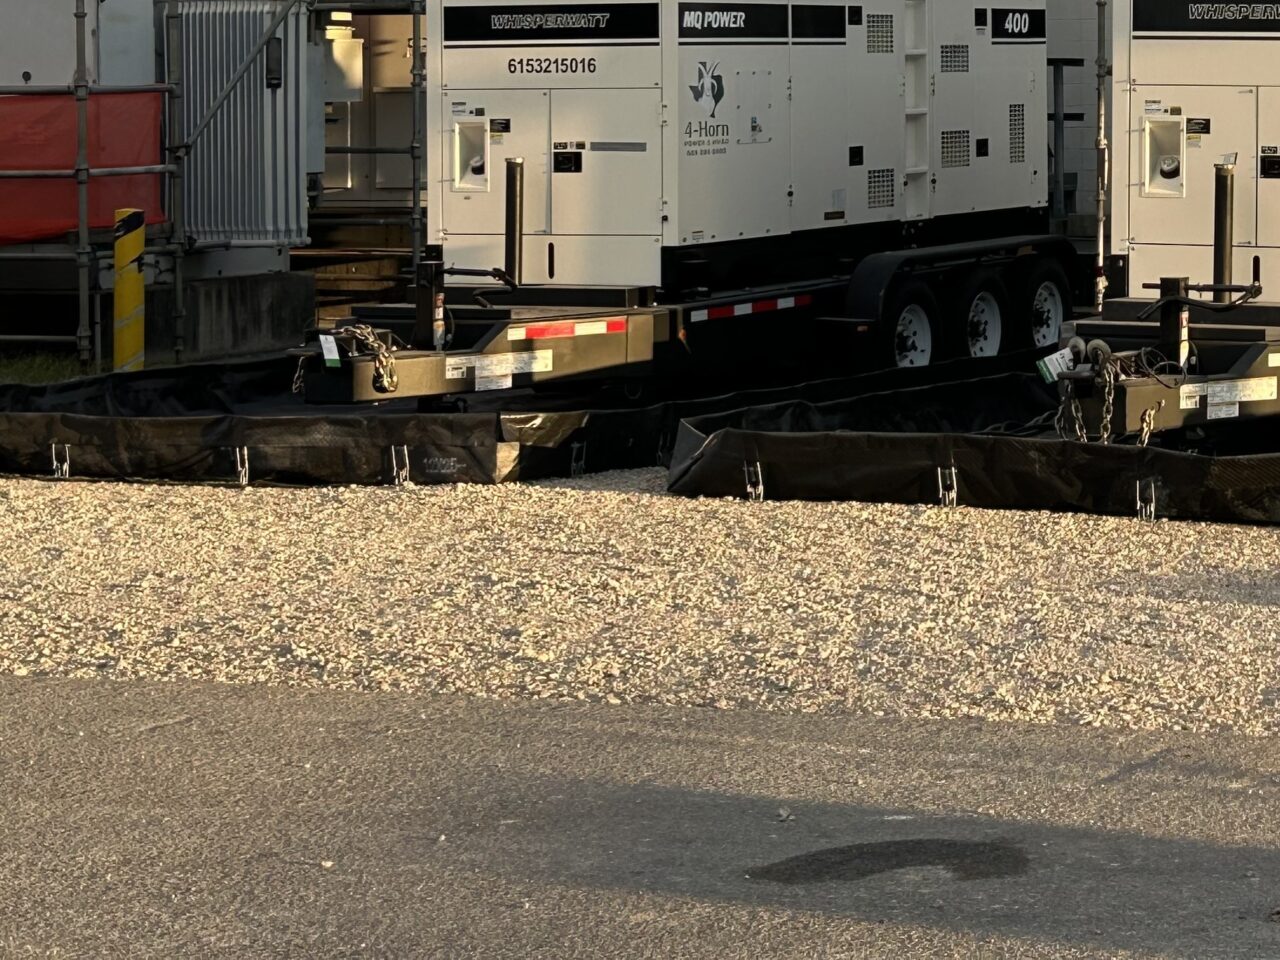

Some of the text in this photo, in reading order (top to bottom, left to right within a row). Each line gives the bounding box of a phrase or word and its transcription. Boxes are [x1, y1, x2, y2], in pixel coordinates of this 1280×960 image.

[490, 12, 611, 29] WHISPERWATT
[683, 11, 746, 30] MQ POWER
[1004, 12, 1030, 34] 400
[507, 57, 597, 74] 6153215016
[684, 121, 730, 138] 4-Horn
